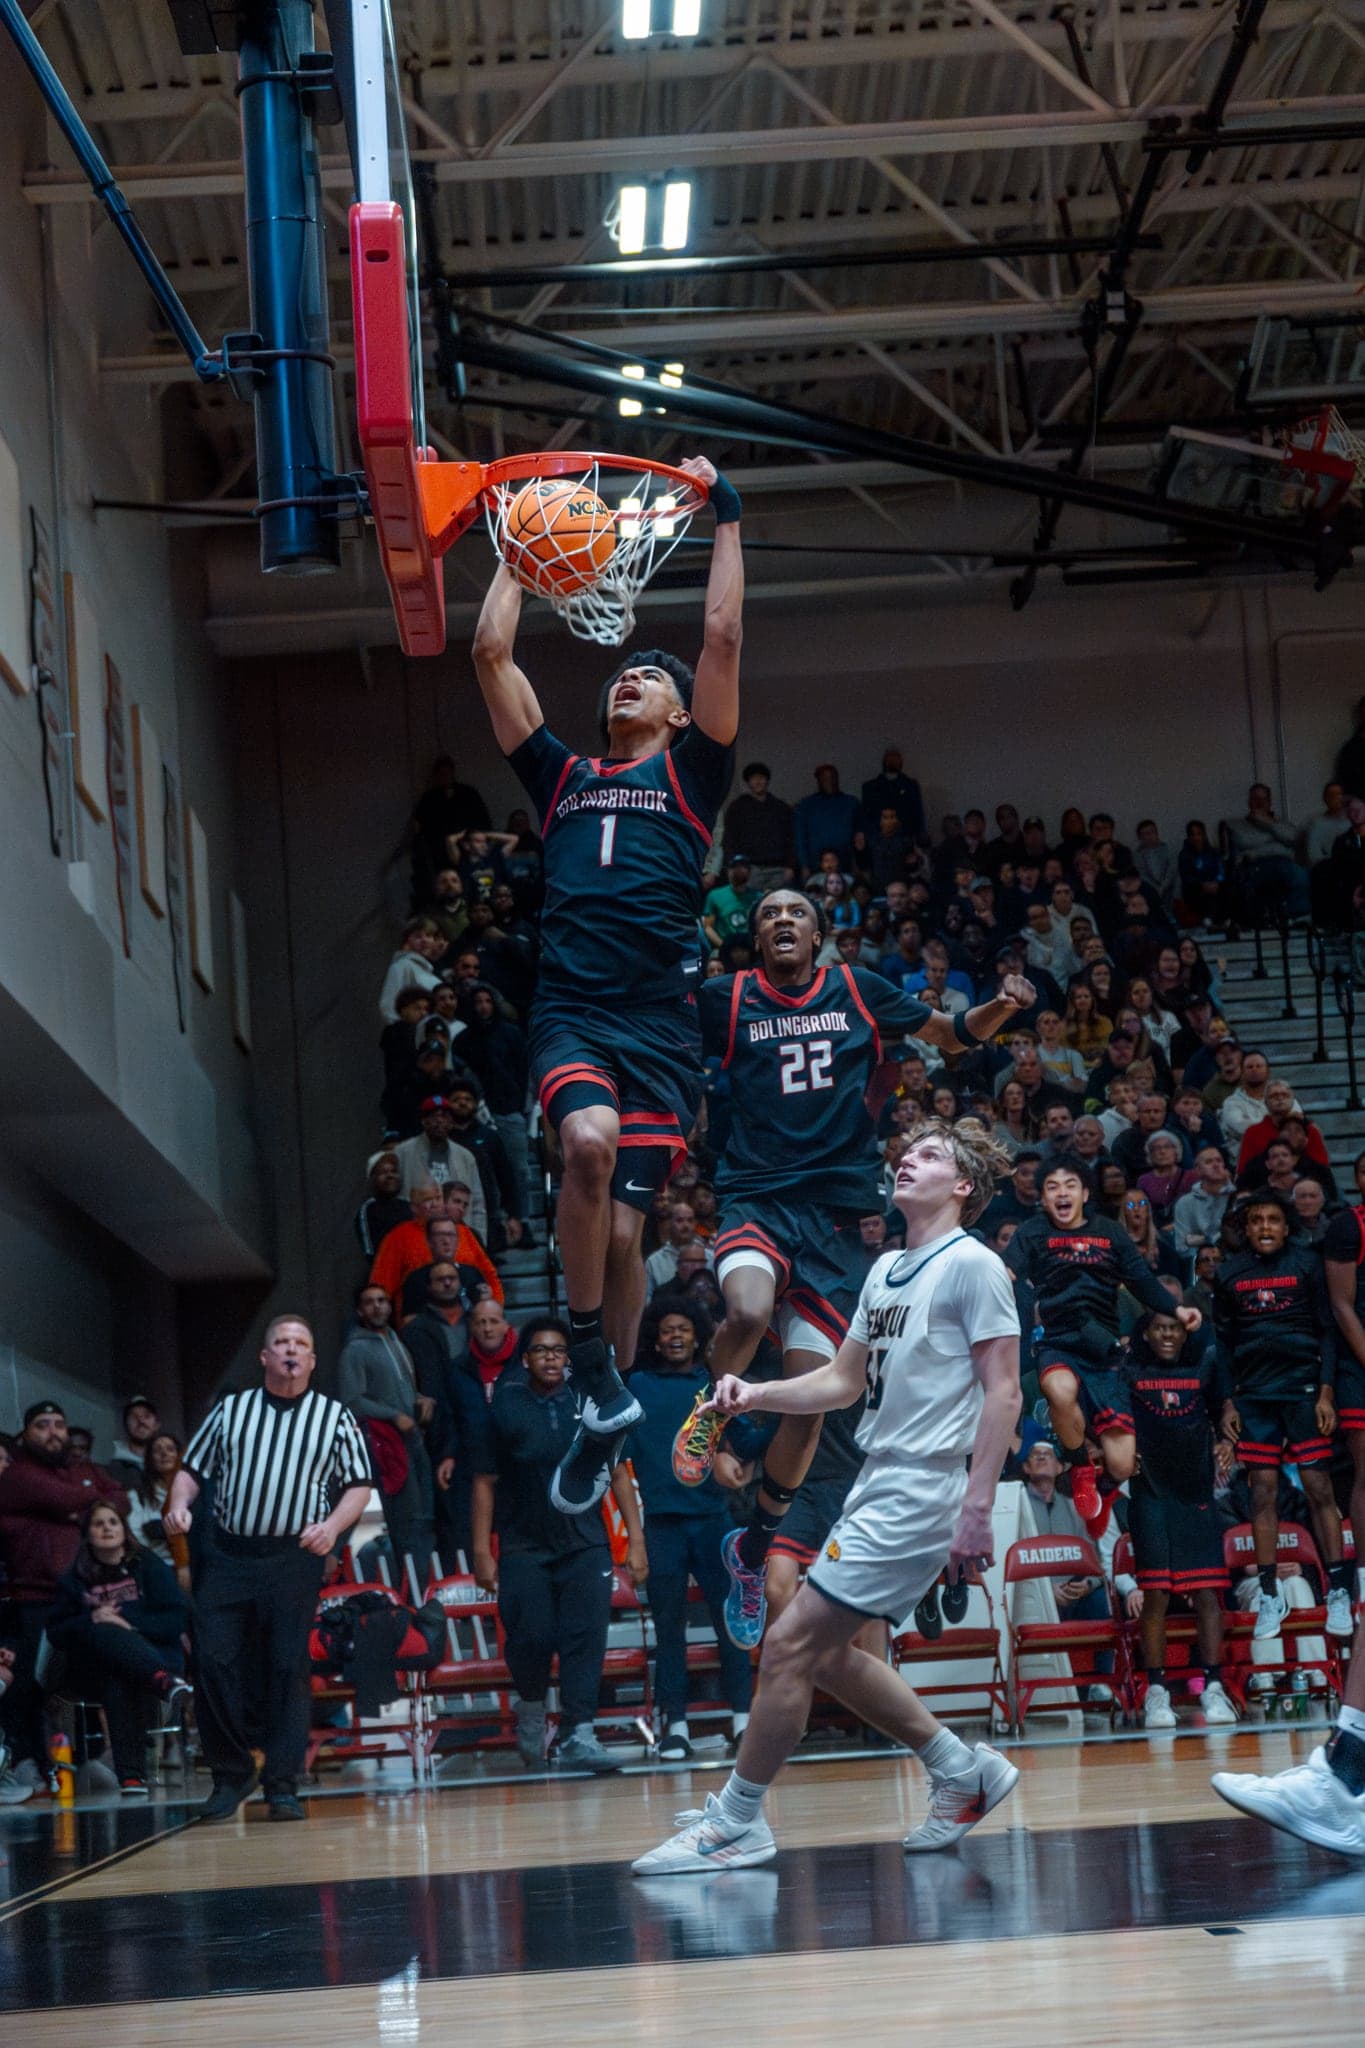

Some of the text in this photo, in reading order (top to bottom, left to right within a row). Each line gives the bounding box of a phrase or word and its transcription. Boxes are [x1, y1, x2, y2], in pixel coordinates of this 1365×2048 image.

[600, 814, 617, 868] 1
[749, 1011, 850, 1042] BOLINGBROOK
[779, 1039, 833, 1094] 22
[1018, 1546, 1082, 1564] RAIDERS
[1234, 1533, 1299, 1551] RARS
